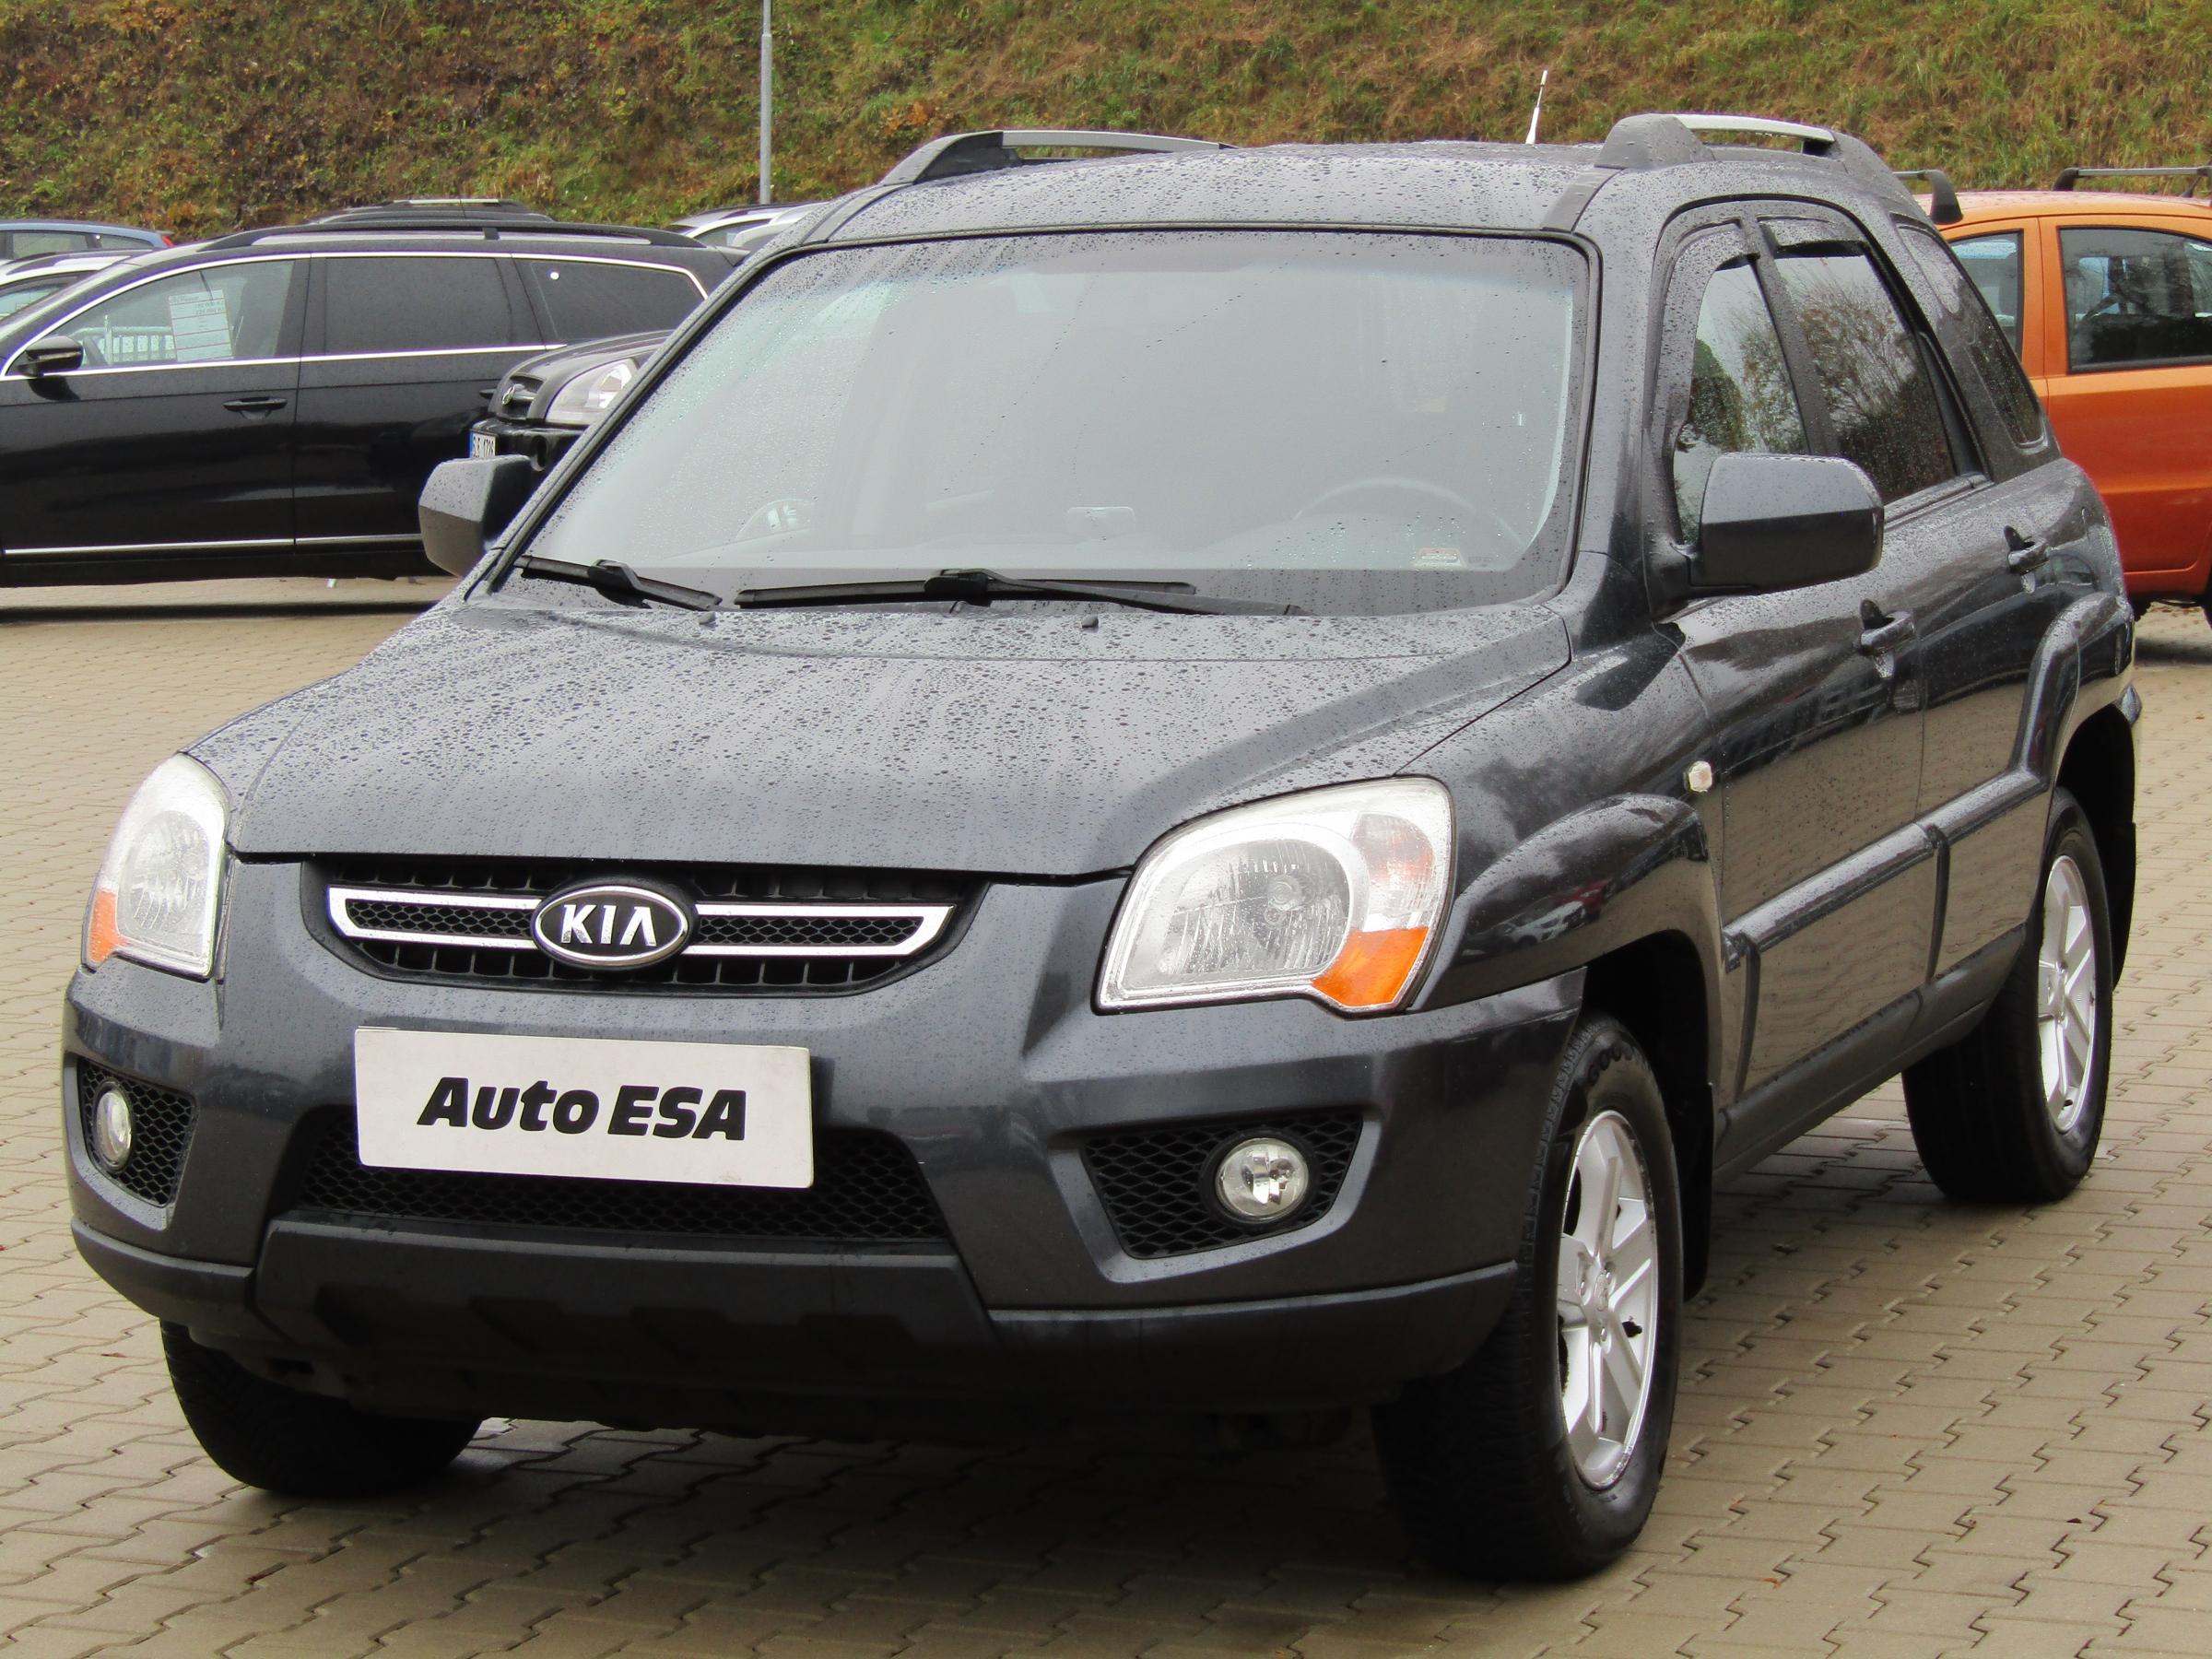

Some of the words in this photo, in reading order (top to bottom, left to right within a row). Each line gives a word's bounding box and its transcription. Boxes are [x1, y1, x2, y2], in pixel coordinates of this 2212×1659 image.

[560, 904, 657, 947] KIA
[417, 1077, 600, 1135] Auto
[607, 1085, 747, 1141] ESA
